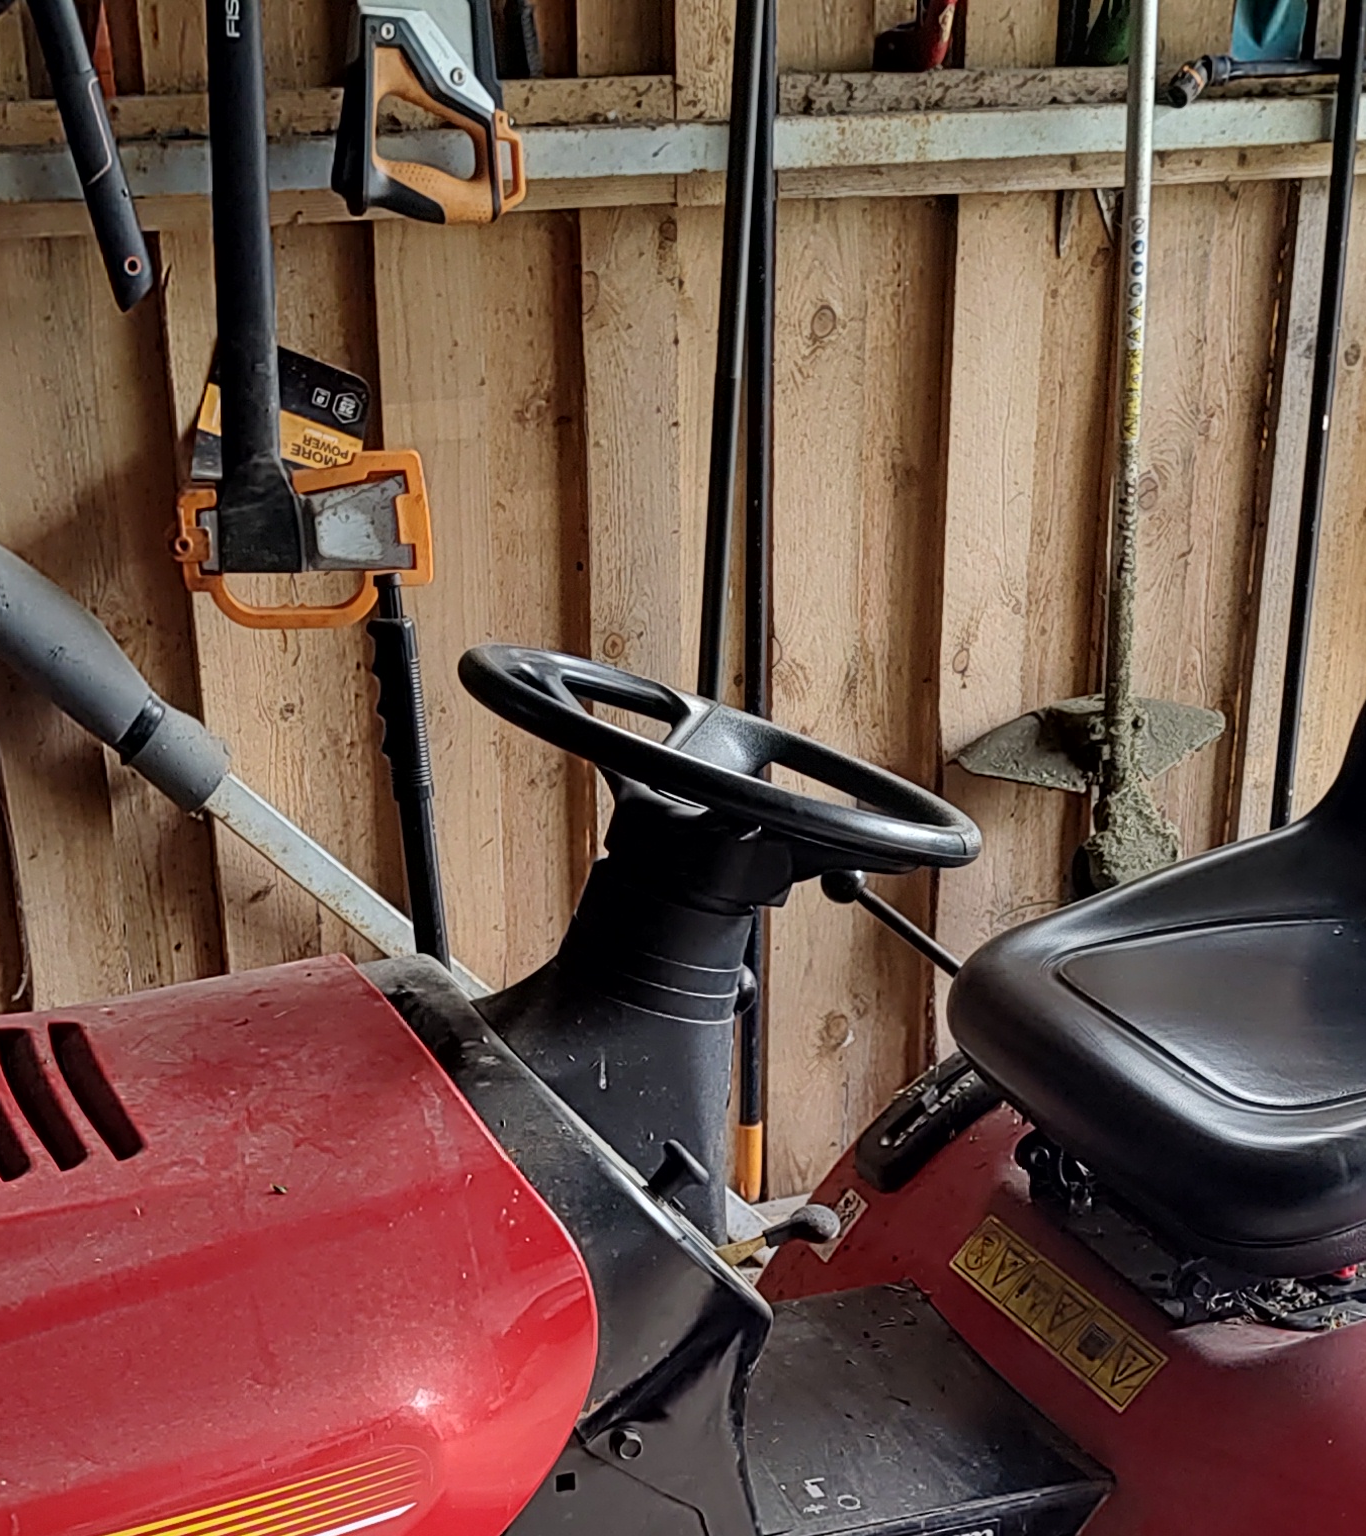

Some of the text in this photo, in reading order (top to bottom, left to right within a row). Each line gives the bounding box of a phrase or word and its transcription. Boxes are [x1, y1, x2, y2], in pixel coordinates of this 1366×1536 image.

[337, 401, 356, 415] 25
[290, 442, 338, 466] MORE
[302, 434, 349, 460] POWER
